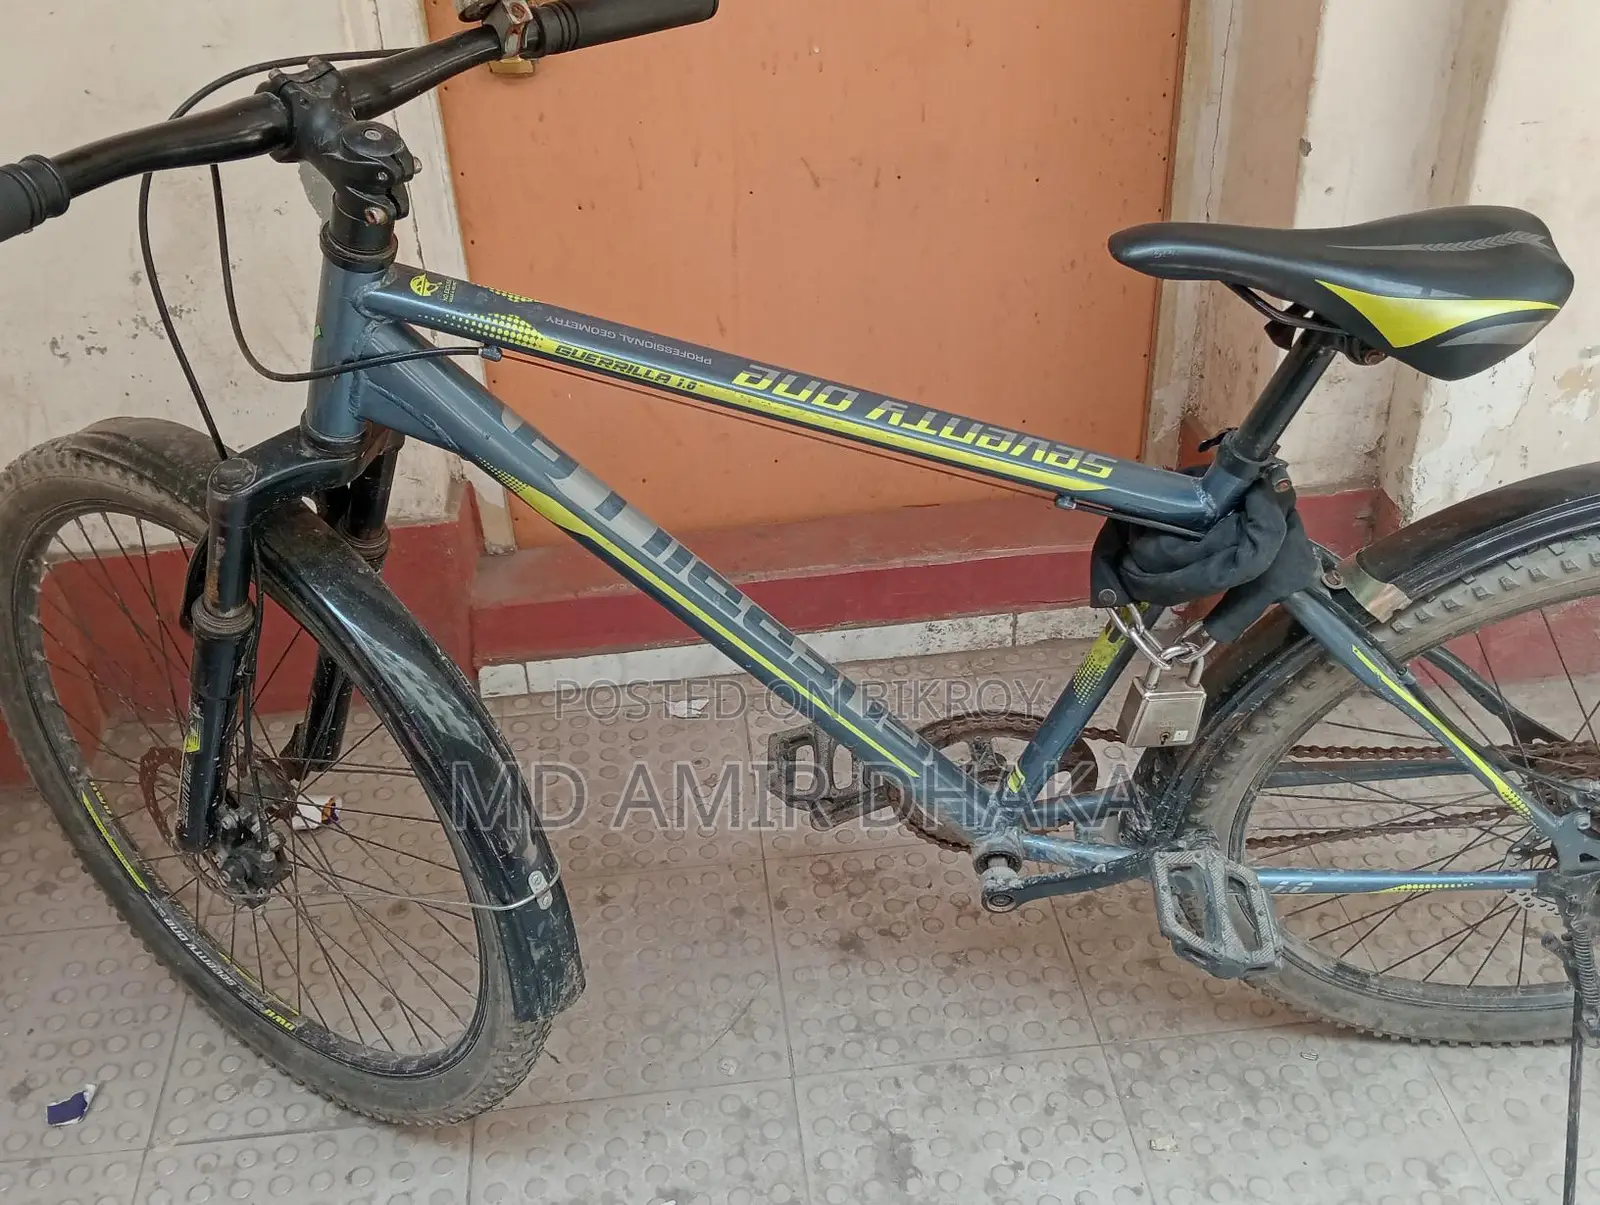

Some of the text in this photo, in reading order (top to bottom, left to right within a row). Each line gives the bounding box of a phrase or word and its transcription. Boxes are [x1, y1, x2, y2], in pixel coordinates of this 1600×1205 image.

[544, 314, 712, 366] PROFESSIONAL GEOMETRY
[554, 344, 672, 382] GUERRILLA
